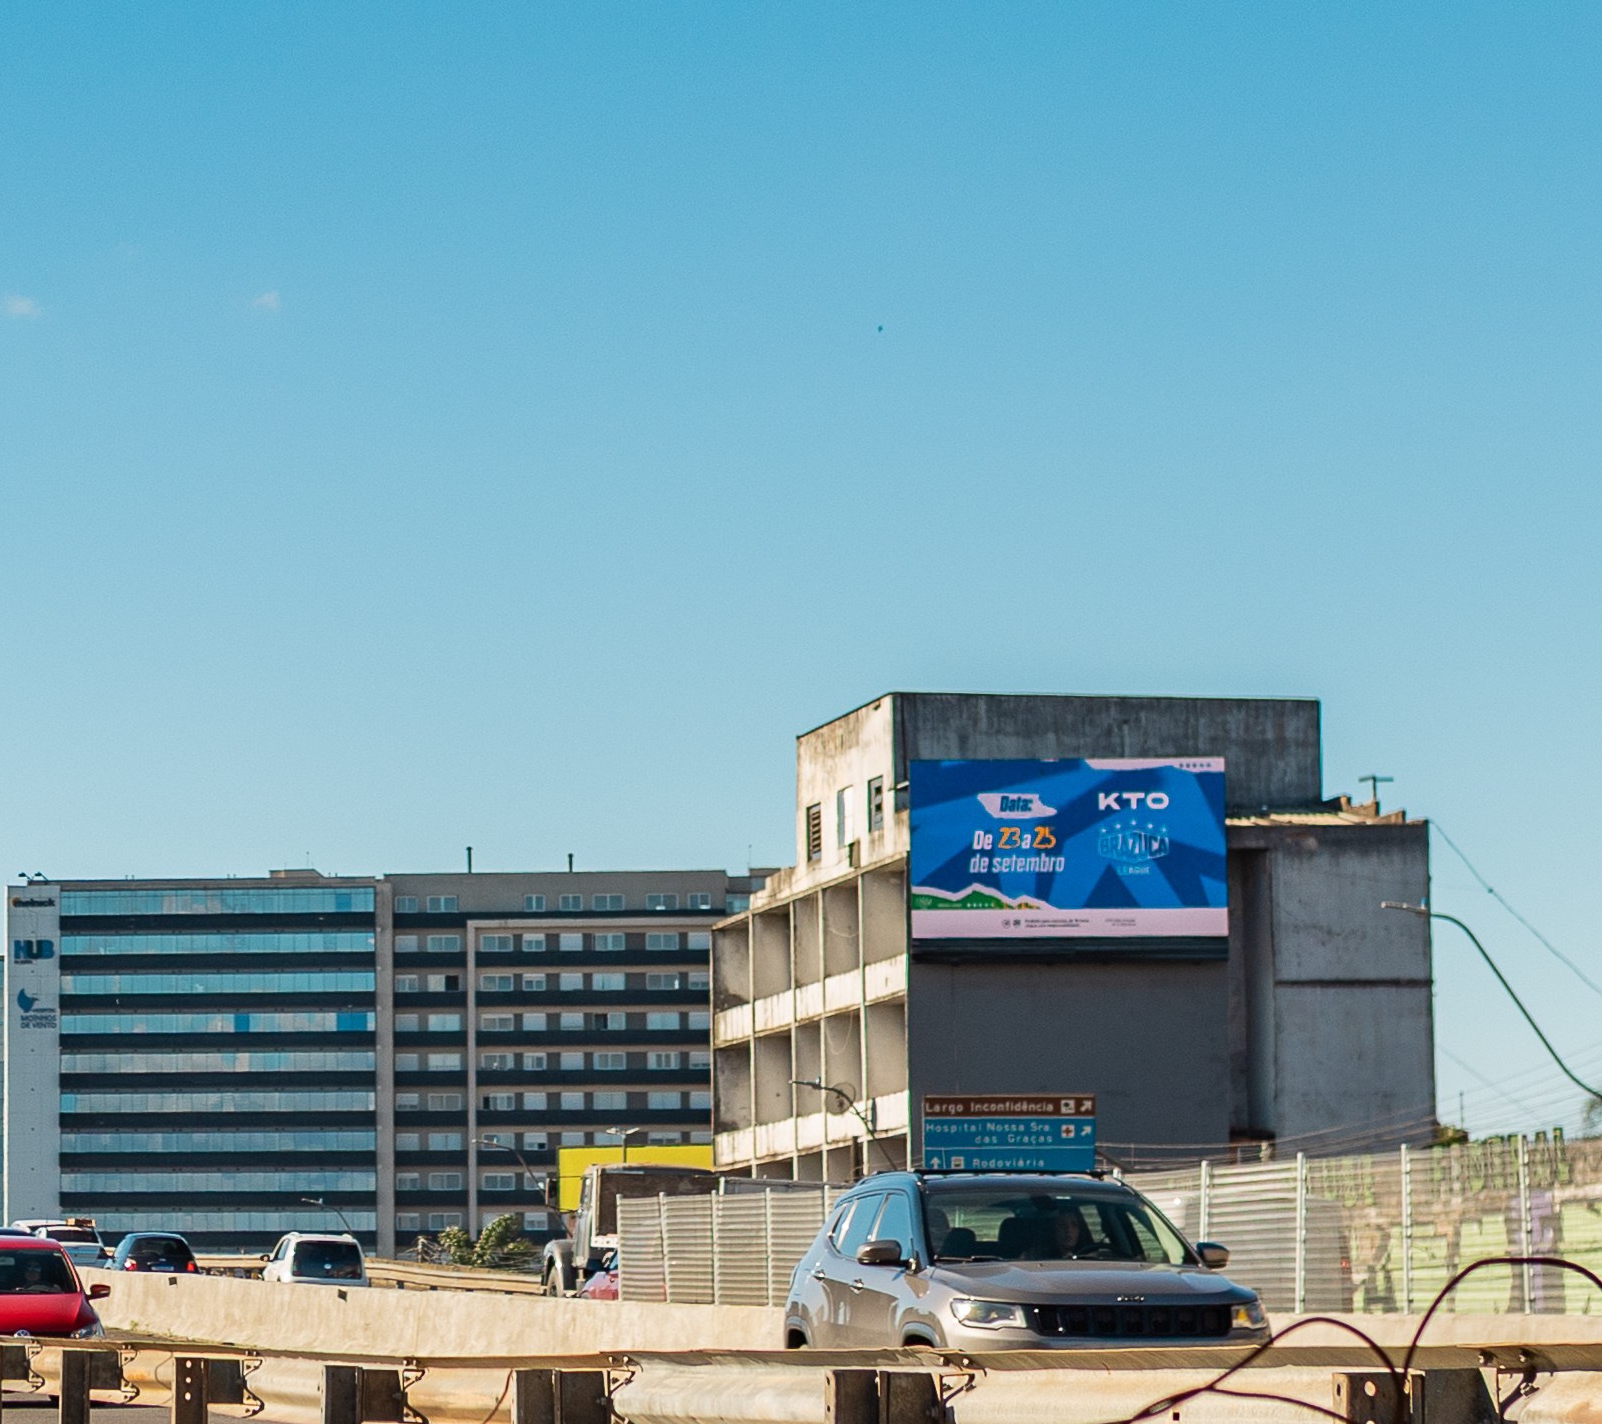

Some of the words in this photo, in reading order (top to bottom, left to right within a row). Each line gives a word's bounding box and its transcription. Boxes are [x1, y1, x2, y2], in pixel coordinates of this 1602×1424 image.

[999, 795, 1033, 813] Data:
[1098, 792, 1170, 811] KTO
[972, 830, 993, 850] De
[998, 827, 1021, 849] 23
[1021, 834, 1031, 849] a
[1032, 826, 1056, 849] 25
[969, 854, 989, 874] de
[992, 852, 1066, 873] setembro
[13, 939, 55, 960] HUB
[925, 1102, 964, 1114] Largo
[970, 1100, 1054, 1113] Inconfidência
[925, 1123, 982, 1133] Hospital
[986, 1122, 1025, 1132] Nossa
[974, 1135, 998, 1144] das
[1007, 1134, 1053, 1145] Graças
[972, 1158, 1045, 1168] Rodoviária
